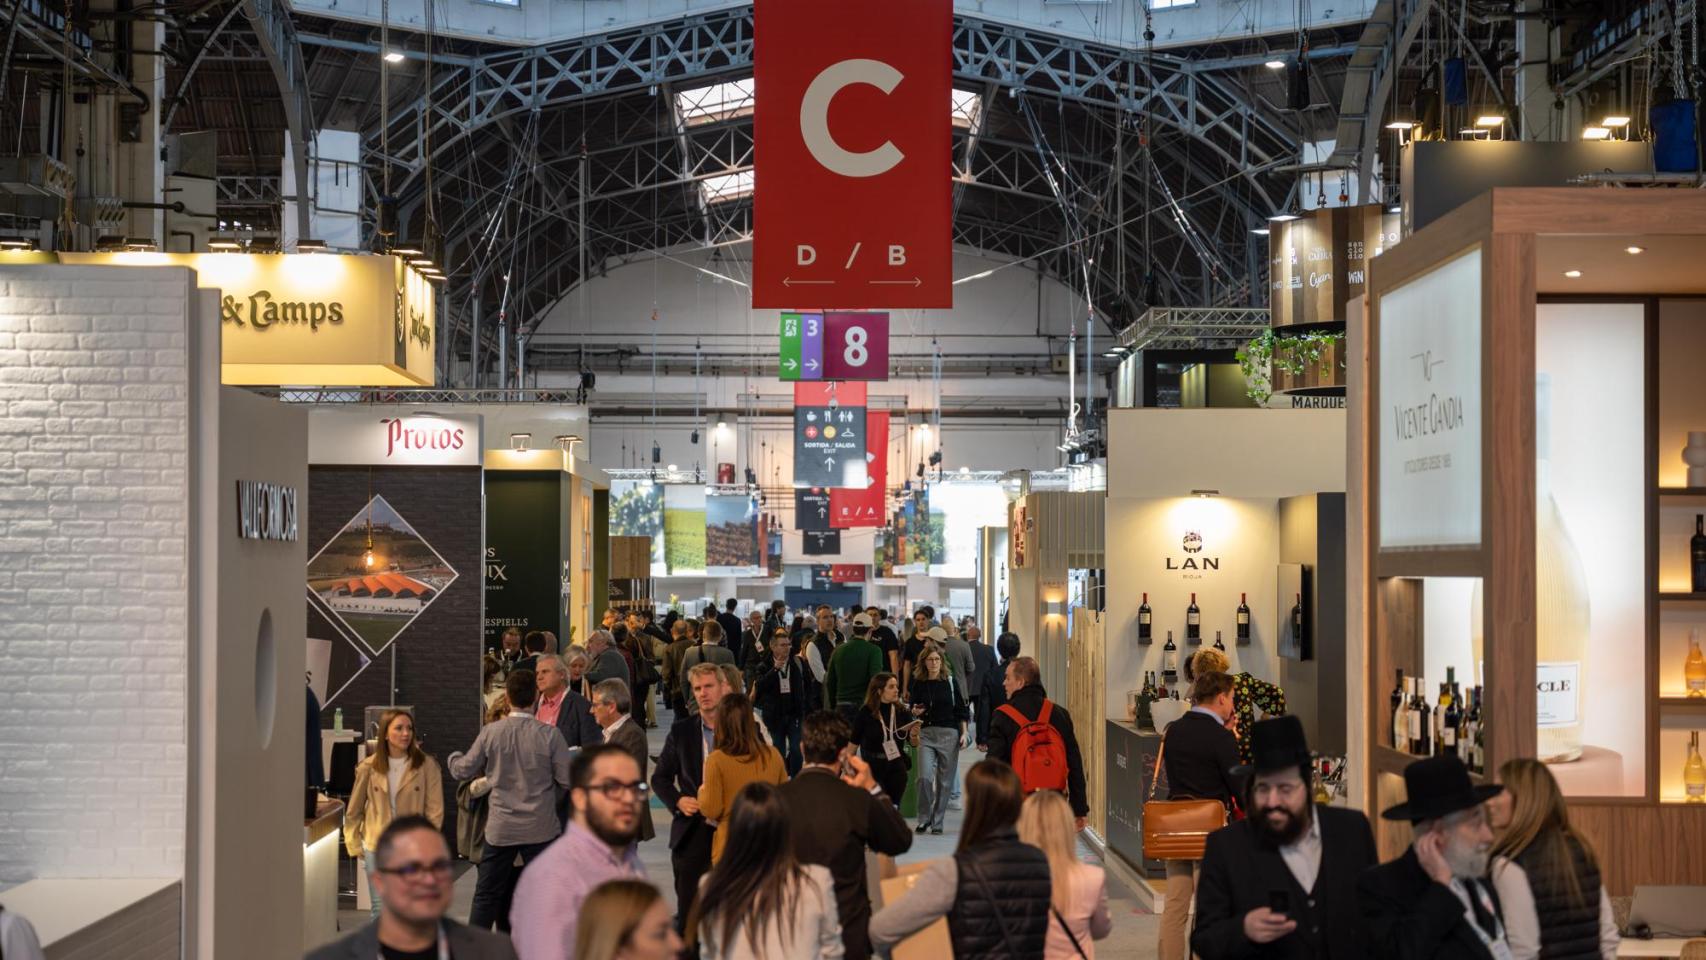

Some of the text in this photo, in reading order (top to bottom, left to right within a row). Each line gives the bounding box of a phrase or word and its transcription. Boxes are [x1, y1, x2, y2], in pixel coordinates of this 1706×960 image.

[800, 58, 905, 178] C
[797, 242, 907, 269] D / B
[221, 290, 345, 332] & Camps
[807, 319, 819, 336] 3
[843, 325, 869, 367] 8
[1292, 396, 1347, 409] MARQUE
[380, 418, 465, 457] Protos
[1393, 403, 1428, 441] VICENTE
[842, 507, 849, 515] E
[867, 507, 875, 515] A
[1165, 557, 1219, 570] LAN
